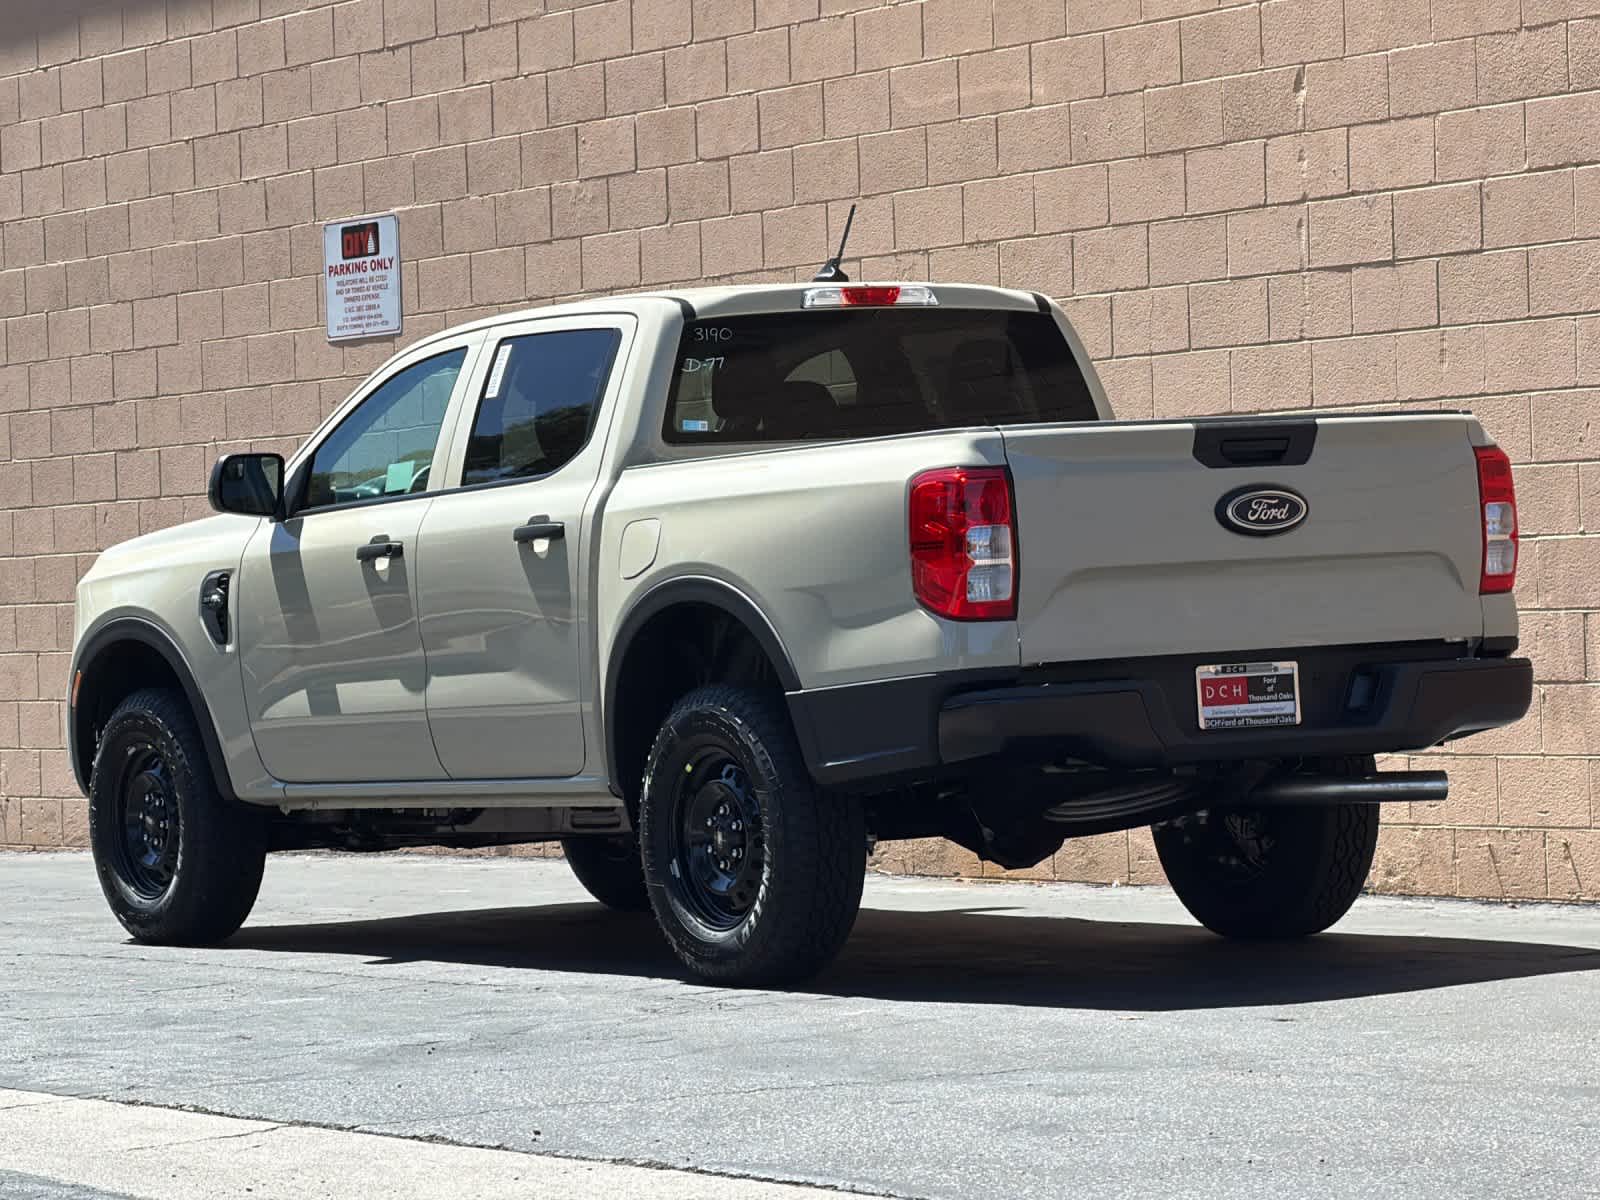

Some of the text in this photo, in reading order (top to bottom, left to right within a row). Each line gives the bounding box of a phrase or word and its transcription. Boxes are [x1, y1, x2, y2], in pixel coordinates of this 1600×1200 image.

[328, 256, 394, 277] PARKING ONLY
[694, 327, 733, 343] 3190
[681, 356, 725, 373] D-77
[1247, 498, 1290, 521] Ford
[1263, 676, 1276, 684] Ford
[1249, 692, 1293, 702] Thousand Oaks
[1237, 716, 1244, 725] of
[1245, 713, 1279, 725] Thousand
